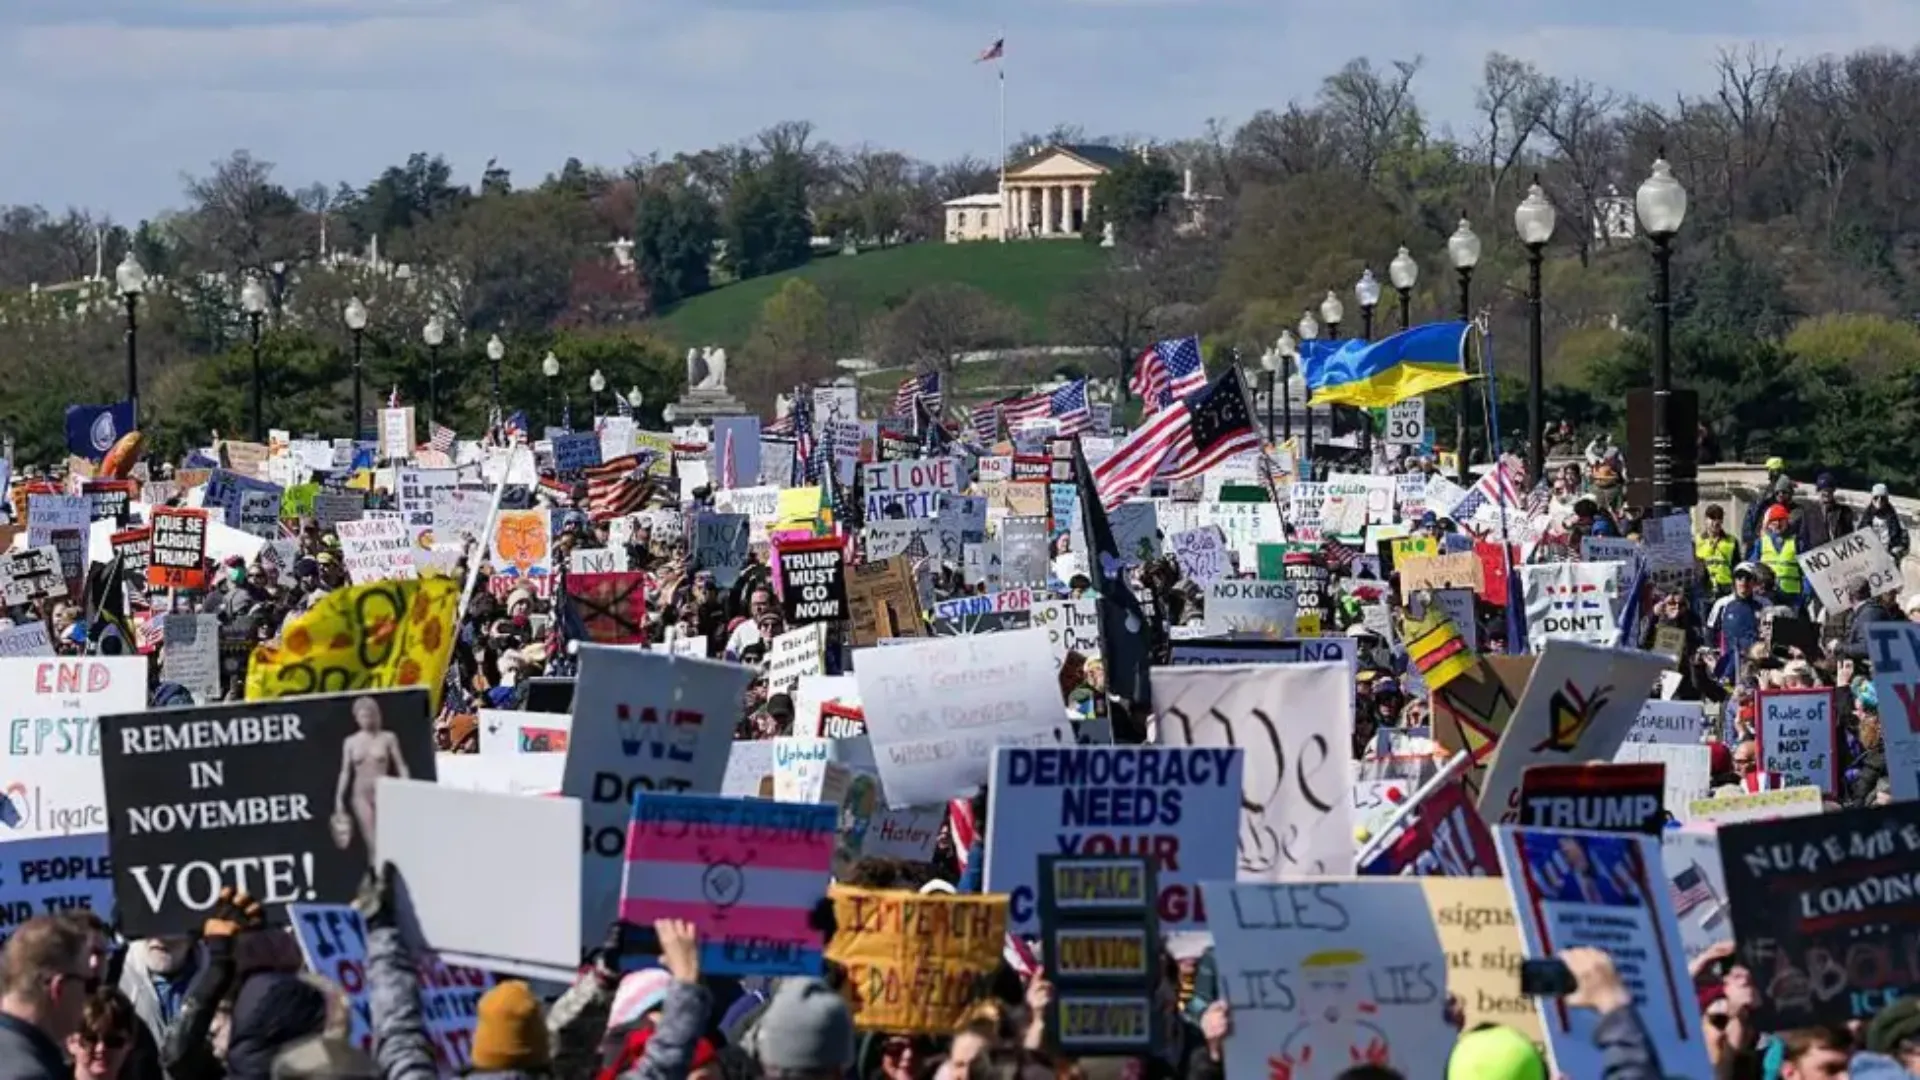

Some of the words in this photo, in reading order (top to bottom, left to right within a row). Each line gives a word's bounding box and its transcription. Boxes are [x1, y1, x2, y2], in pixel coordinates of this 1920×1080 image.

[1391, 420, 1419, 438] 30
[868, 466, 890, 491] I
[893, 461, 953, 491] LOVE
[982, 461, 1000, 471] NO
[187, 517, 202, 531] SE
[708, 522, 737, 544] NO
[154, 533, 201, 549] LARGUE
[1401, 541, 1426, 551] NO
[155, 550, 200, 567] TRUMP
[781, 551, 840, 570] TRUMP
[1806, 550, 1830, 573] NO
[1832, 534, 1871, 560] WAR
[789, 570, 836, 586] MUST
[802, 585, 828, 601] GO
[1213, 584, 1238, 598] NO
[1242, 583, 1293, 600] KINGS
[1298, 593, 1319, 606] GO
[795, 601, 840, 618] NOW!
[938, 596, 993, 617] STAND
[996, 590, 1031, 612] FOR
[1544, 615, 1603, 633] DON'T
[36, 662, 111, 693] END
[880, 676, 918, 695] THE
[63, 700, 80, 709] THE
[1767, 704, 1801, 721] Rule
[1807, 701, 1826, 720] of
[121, 713, 305, 755] REMEMBER
[616, 703, 705, 762] WE
[1779, 724, 1809, 738] Law
[776, 743, 827, 767] Uphold
[1778, 741, 1809, 754] NOT
[1008, 750, 1237, 787] DEMOCRACY
[1767, 755, 1801, 771] Rule
[1808, 754, 1826, 770] of
[189, 760, 225, 789] IN
[127, 794, 313, 835] NOVEMBER
[1060, 788, 1183, 827] NEEDS
[1527, 794, 1659, 828] TRUMP
[20, 857, 113, 884] PEOPLE
[128, 852, 317, 914] VOTE!
[0, 901, 33, 925] ND
[849, 895, 992, 938] IMPEACH
[1231, 884, 1348, 931] LIES
[1439, 902, 1516, 934] signs
[1222, 968, 1296, 1012] LIES
[1367, 963, 1438, 1005] LIES
